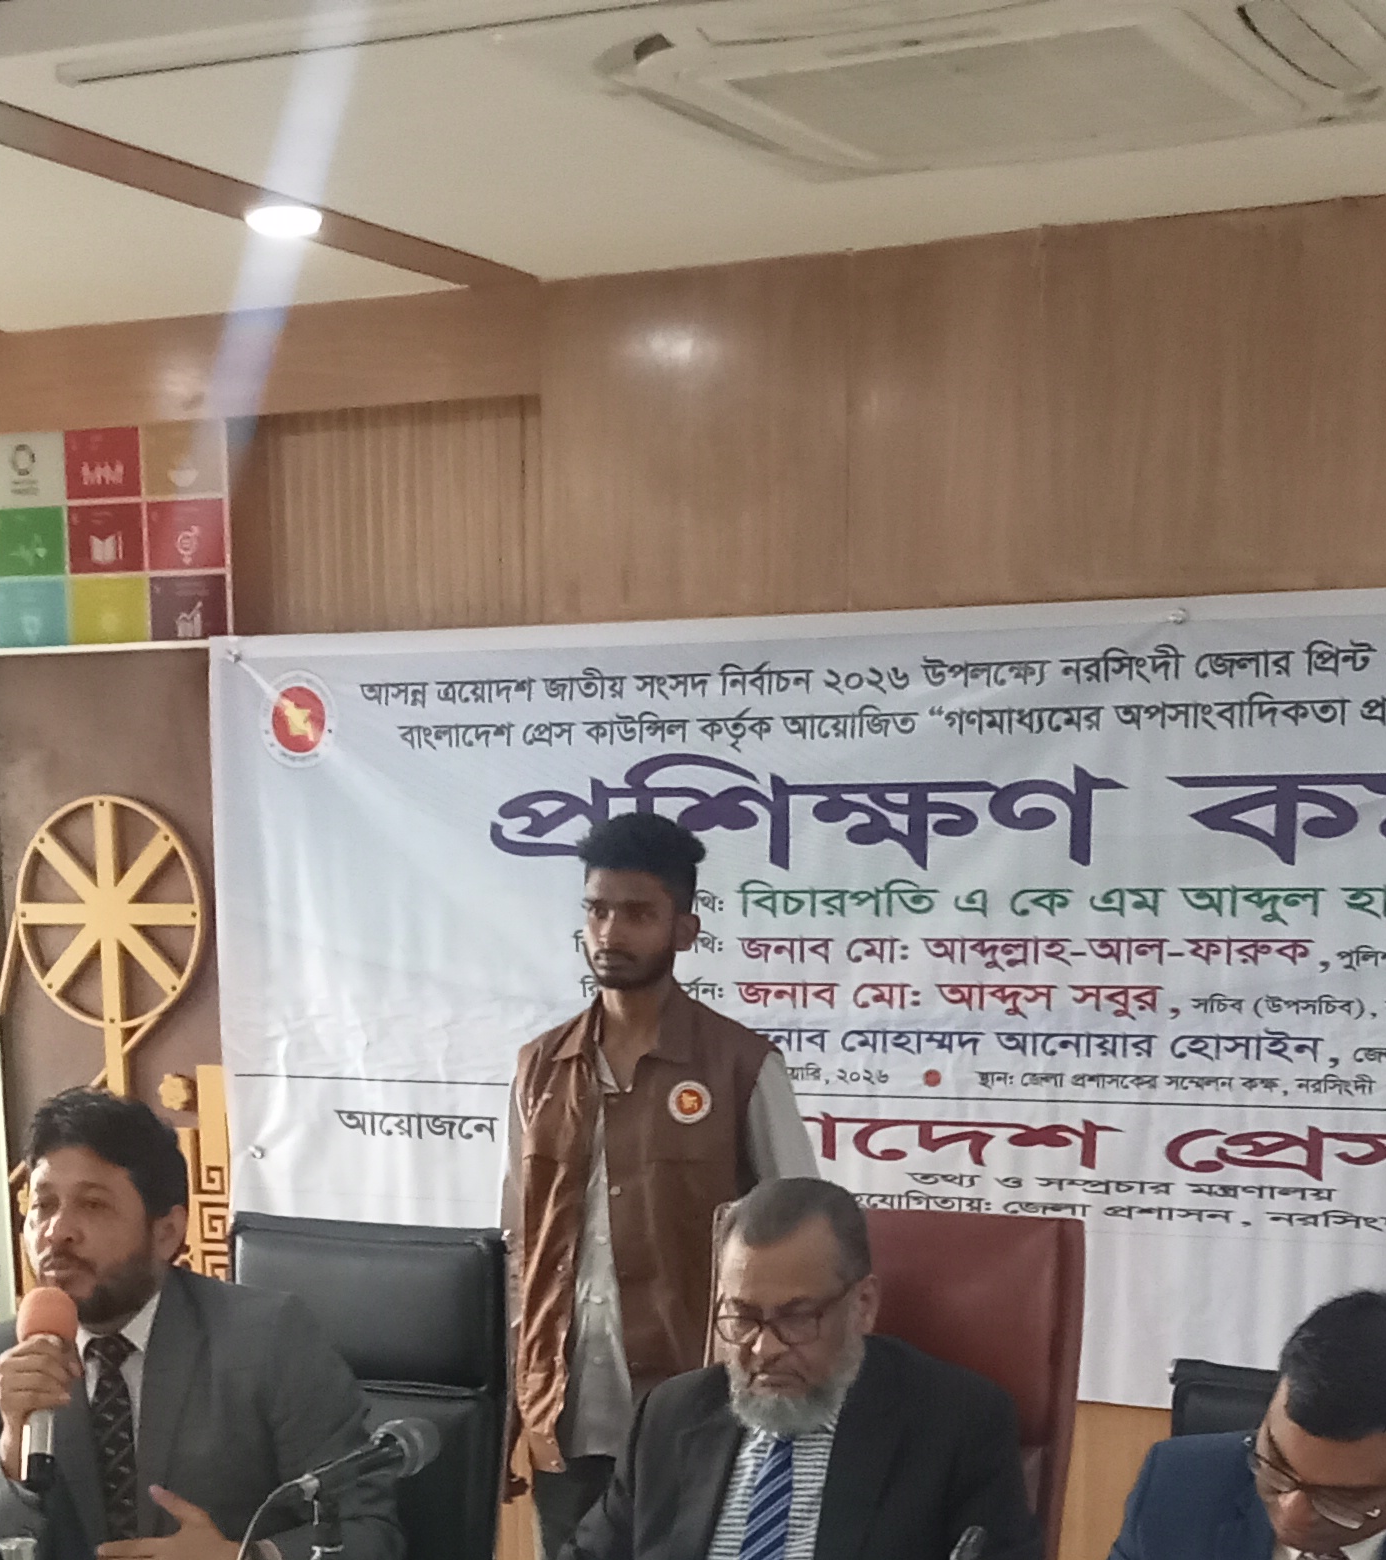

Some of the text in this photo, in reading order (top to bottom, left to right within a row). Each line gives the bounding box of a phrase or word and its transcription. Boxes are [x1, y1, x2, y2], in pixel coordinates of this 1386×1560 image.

[360, 680, 426, 708] আসন্ন
[437, 677, 535, 704] ত্রয়োদশ
[544, 668, 624, 702] জাতীয়
[636, 672, 709, 702] সংসদ
[719, 661, 815, 696] নির্বাচন
[824, 665, 909, 697] ২০২৬
[922, 656, 1051, 688] উপলক্ষ্যে
[1060, 645, 1184, 684] নরসিংদী
[1195, 648, 1290, 678] জেলার
[1305, 639, 1375, 677] প্রিন্ট
[398, 721, 515, 751] বাংলাদেশ
[523, 720, 576, 747] প্রেস
[583, 709, 688, 744] কাউন্সিল
[698, 710, 773, 754] কর্তৃক
[782, 705, 918, 741] আয়োজিত
[928, 703, 1105, 737] “গণমাধ্যমের
[1114, 693, 1348, 733] অপসাংবাদিকতা
[490, 752, 1130, 870] প্রশিক্ষণ
[737, 878, 939, 918] বিচারপতি
[955, 890, 990, 917] এ
[1010, 889, 1074, 917] কে
[1090, 886, 1164, 918] এম
[1178, 884, 1327, 925] আব্দুল
[737, 936, 836, 965] জনাব
[734, 980, 840, 1010] জনাব
[937, 982, 1060, 1020] আব্দুস
[1071, 984, 1181, 1021] সবুর,
[1190, 993, 1245, 1014] সচিব
[749, 1027, 831, 1054] নাব
[840, 1028, 985, 1057] মোহাম্মদ
[996, 1030, 1160, 1060] আনোয়ার
[1170, 1029, 1341, 1068] হোসাইন,
[837, 1068, 890, 1085] ২০২৬
[1020, 1071, 1064, 1089] জেলা
[1070, 1072, 1159, 1090] প্রশাসকের
[1295, 1072, 1376, 1097] নরসিংদী
[334, 1108, 500, 1143] আয়োজনে
[802, 1111, 1126, 1170] াদেশ
[905, 1172, 981, 1189] তথ্য
[995, 1175, 1024, 1189] ও
[1034, 1176, 1171, 1198] সম্প্রচার
[1003, 1199, 1094, 1222] জেলা
